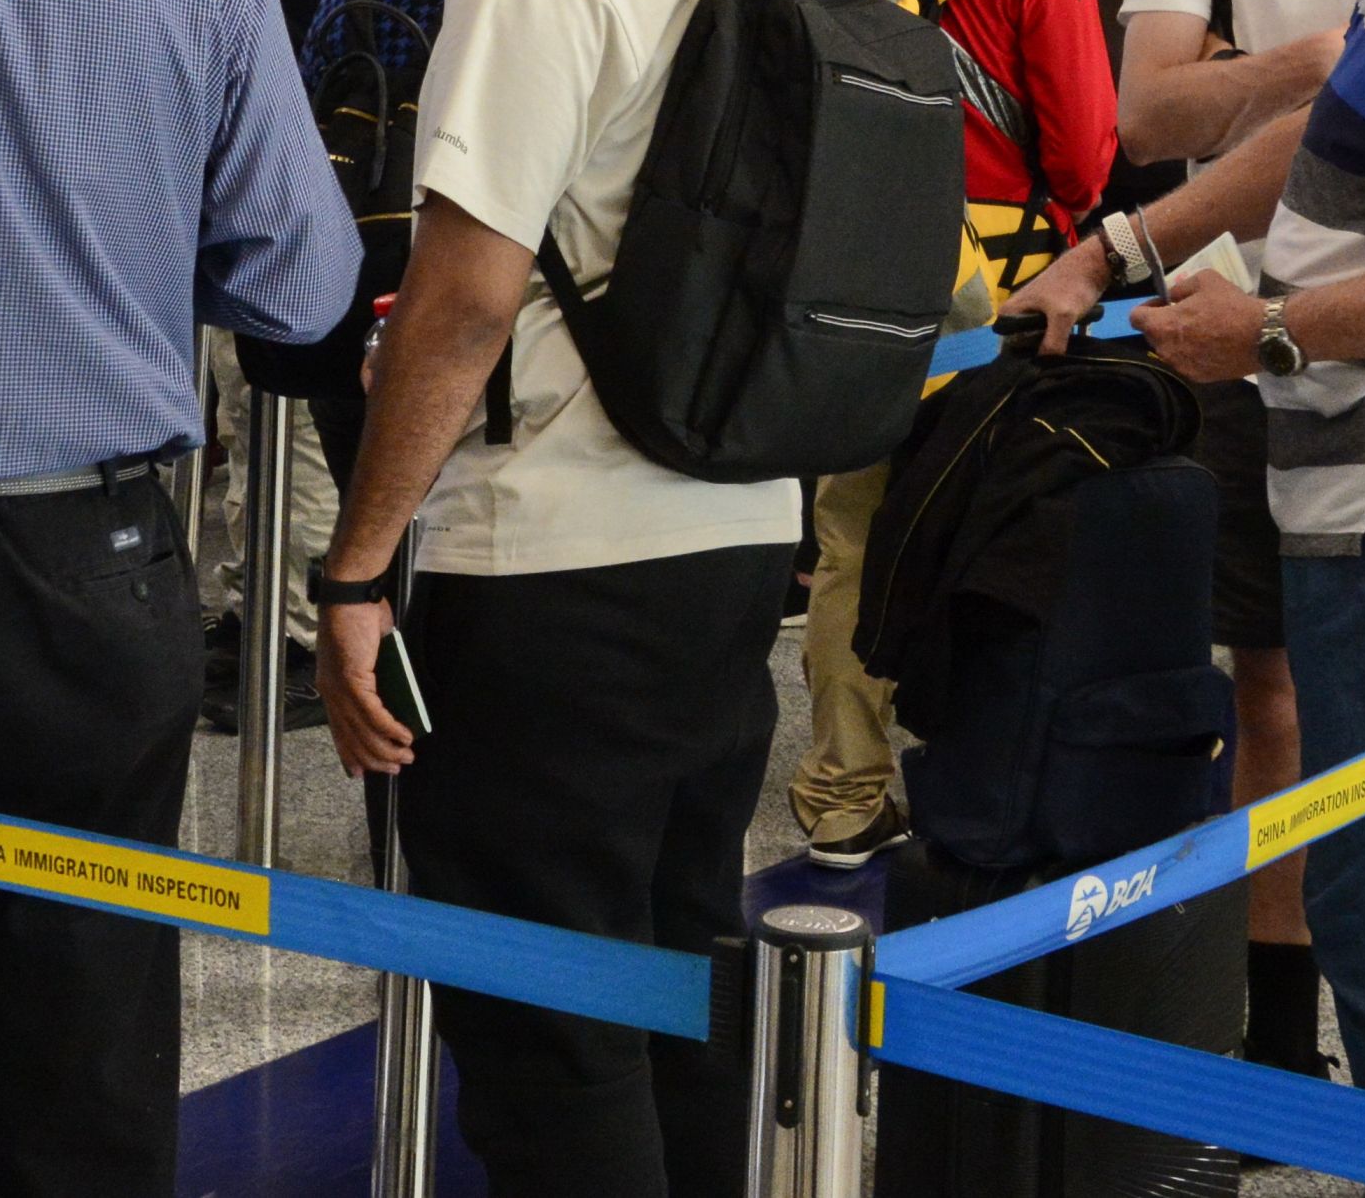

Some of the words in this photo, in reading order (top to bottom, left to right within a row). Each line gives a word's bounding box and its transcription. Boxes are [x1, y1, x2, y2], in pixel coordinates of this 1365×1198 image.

[1257, 818, 1285, 848] CHINA
[1289, 788, 1350, 832] IMMIGRATION
[13, 847, 129, 889] IMMIGRATION
[137, 871, 241, 911] INSPECTION
